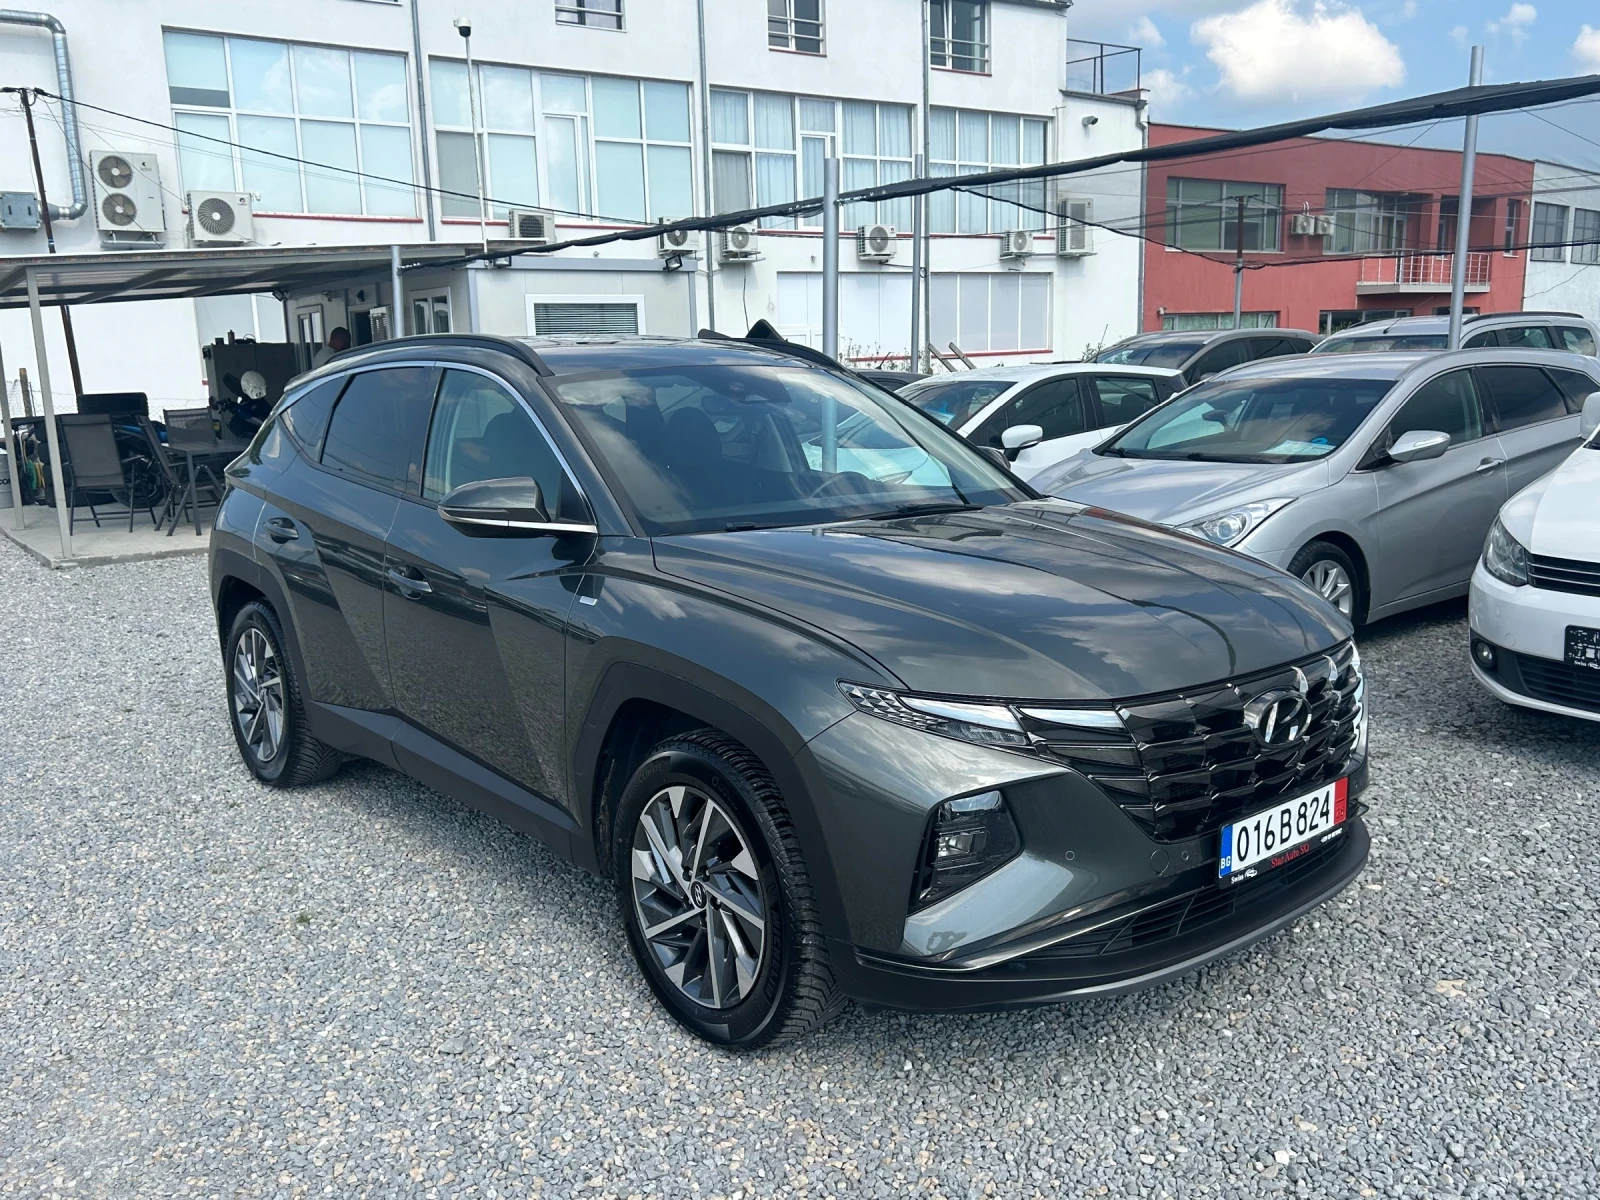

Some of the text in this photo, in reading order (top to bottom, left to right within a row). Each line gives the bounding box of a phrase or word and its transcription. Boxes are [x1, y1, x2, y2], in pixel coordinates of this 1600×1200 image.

[1220, 855, 1231, 869] BG
[1284, 850, 1300, 862] Auto
[1231, 874, 1244, 884] Swiss
